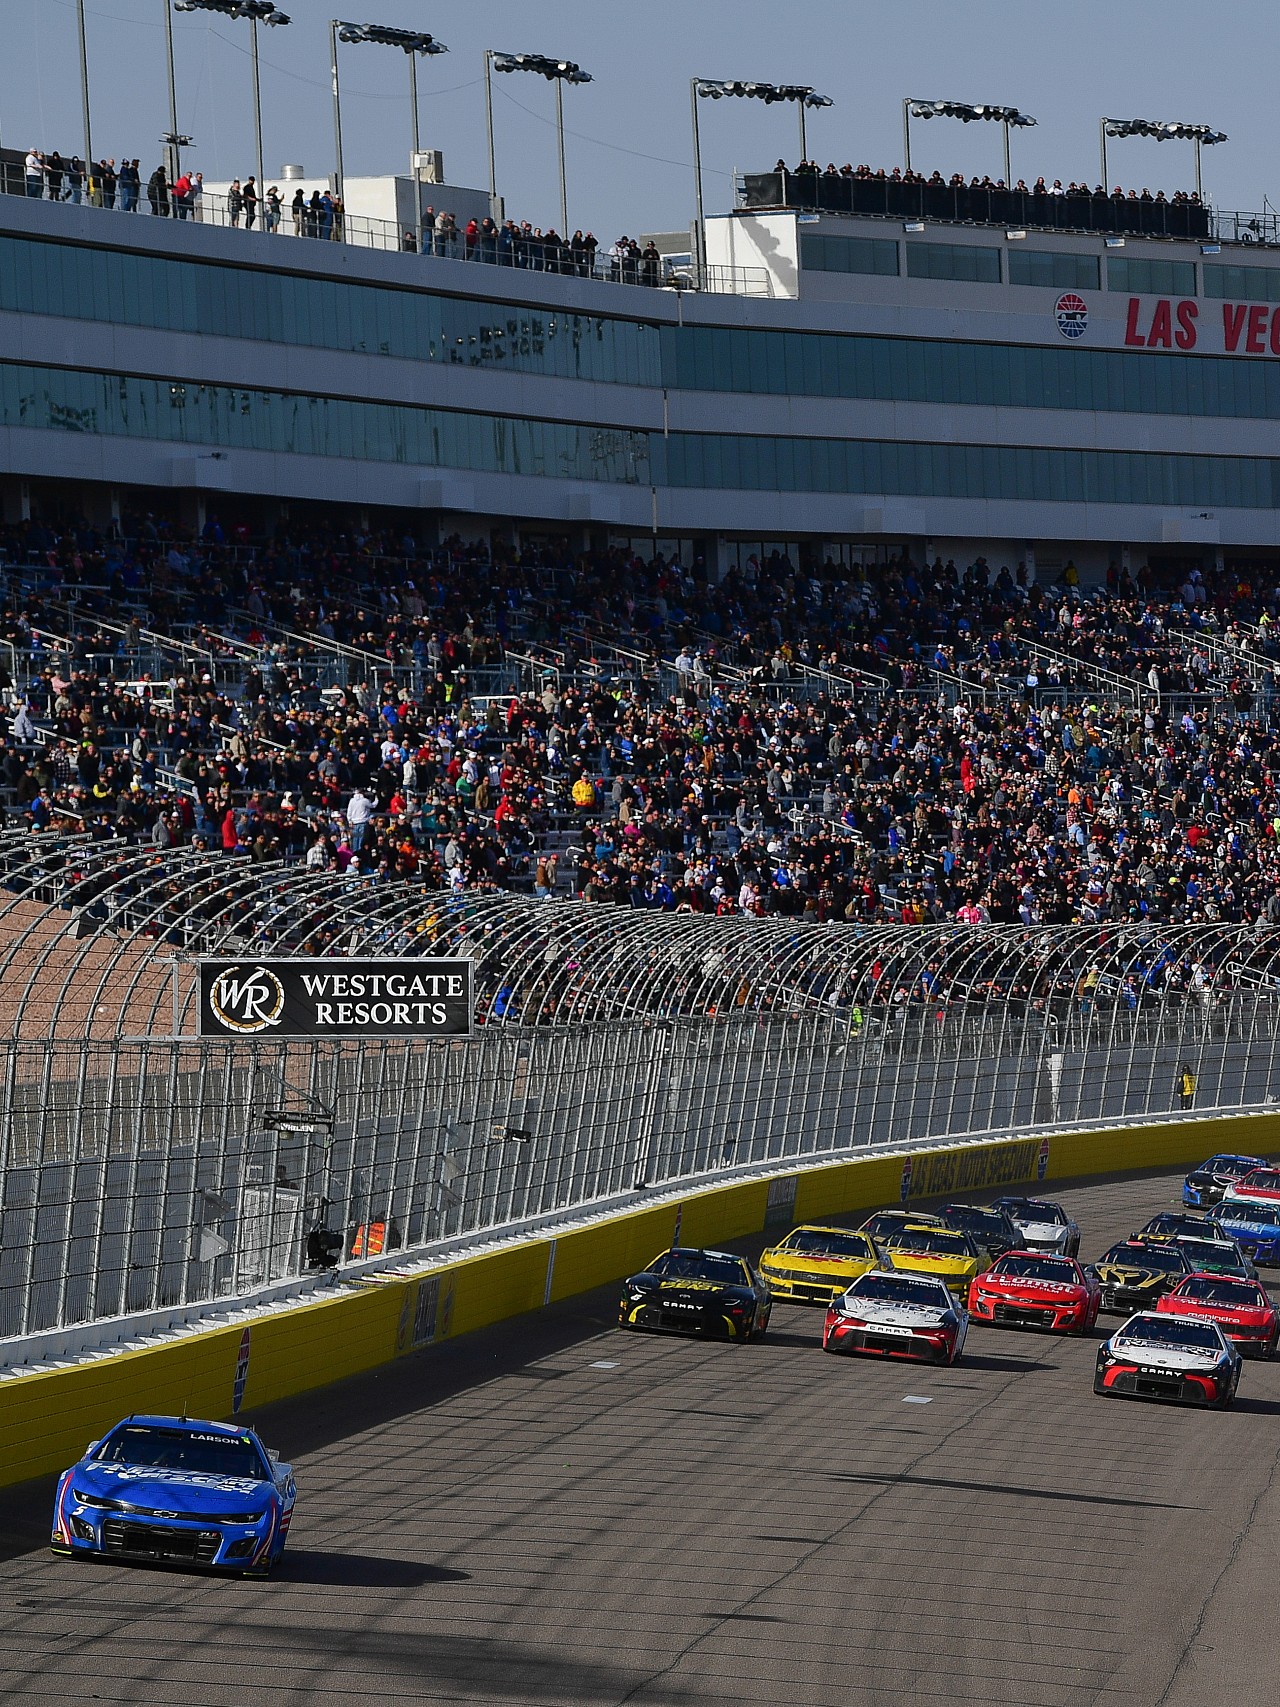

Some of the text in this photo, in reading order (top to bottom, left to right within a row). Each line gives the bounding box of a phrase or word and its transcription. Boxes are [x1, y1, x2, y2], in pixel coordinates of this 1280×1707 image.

[1125, 298, 1199, 349] LAS
[300, 974, 464, 998] WESTGATE
[315, 1002, 447, 1025] RESORTS
[663, 1301, 704, 1310] CAMRY
[1187, 1312, 1240, 1323] mahindra
[1174, 1320, 1200, 1328] TRUEX
[869, 1325, 910, 1335] CAMRY
[1140, 1367, 1182, 1378] CAMRY
[190, 1433, 239, 1445] LARSON
[71, 1505, 88, 1516] 5
